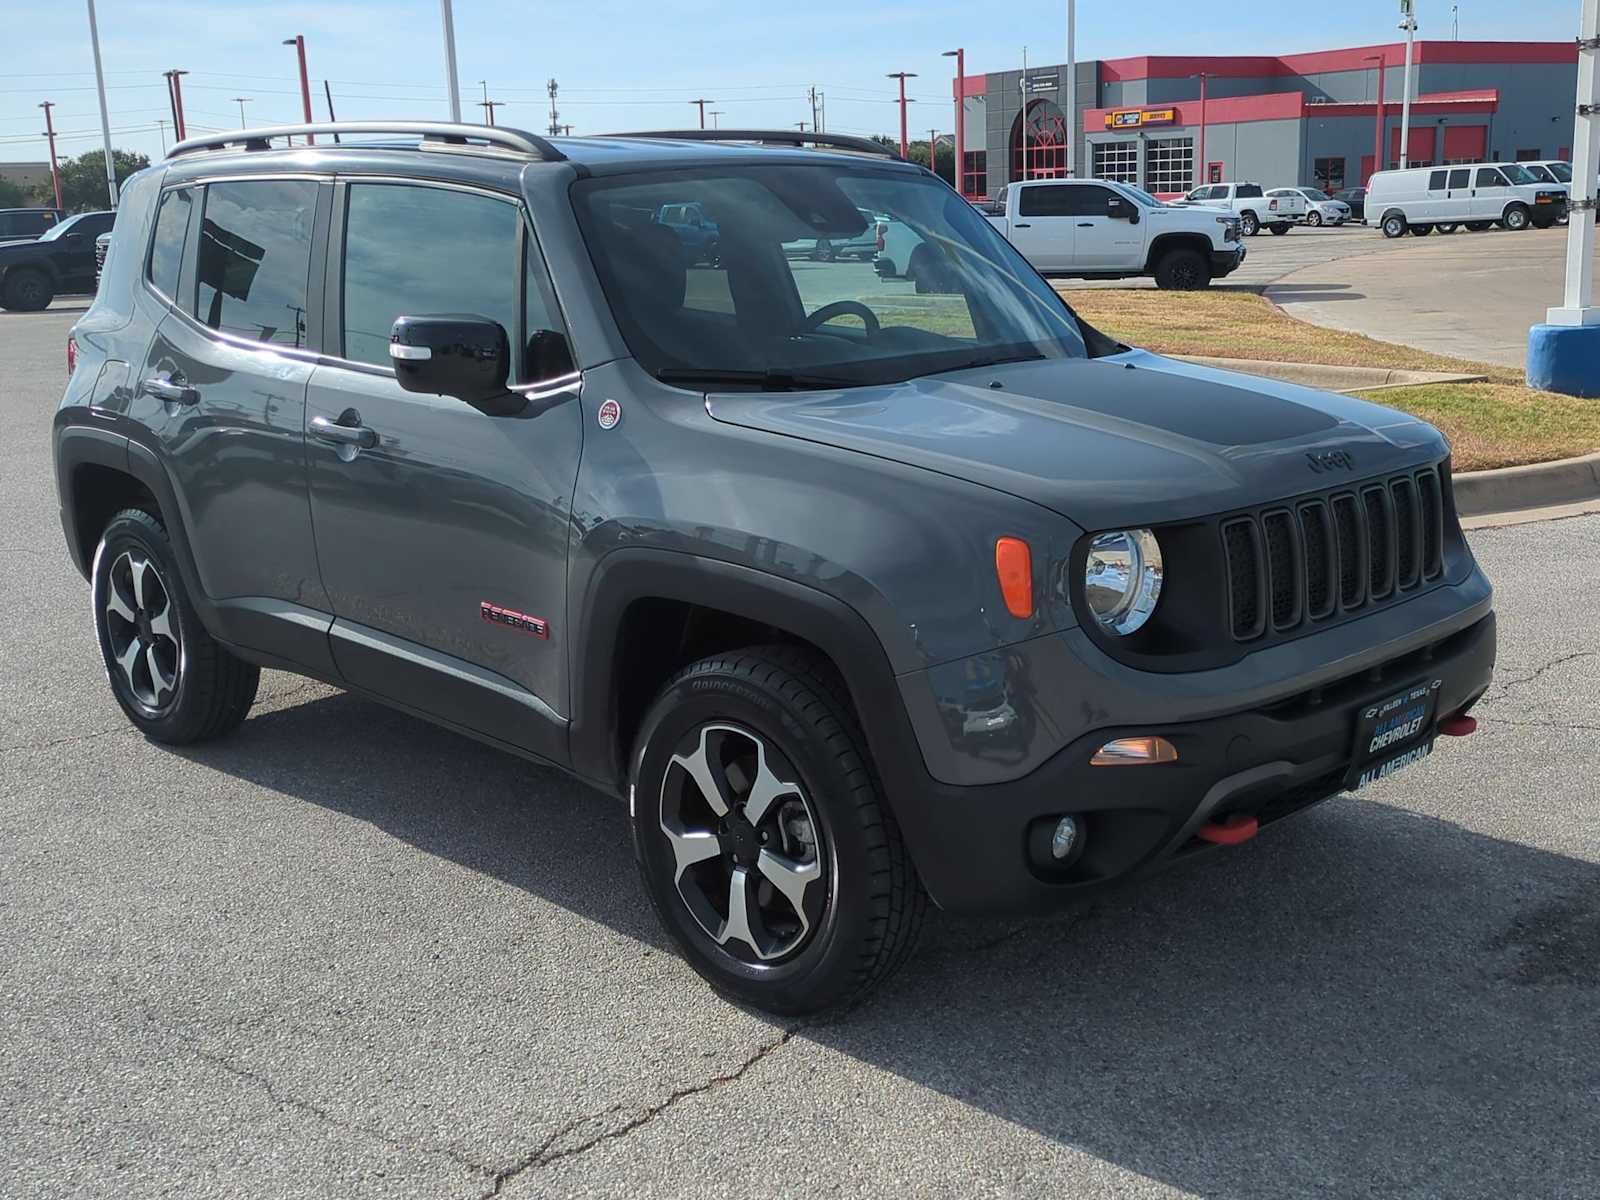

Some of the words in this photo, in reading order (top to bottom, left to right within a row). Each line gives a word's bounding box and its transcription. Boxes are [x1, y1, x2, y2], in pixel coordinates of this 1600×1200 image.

[1369, 716, 1424, 752] CHEVROLET
[1359, 769, 1378, 791] ALL
[1379, 743, 1430, 778] AMERICAN
